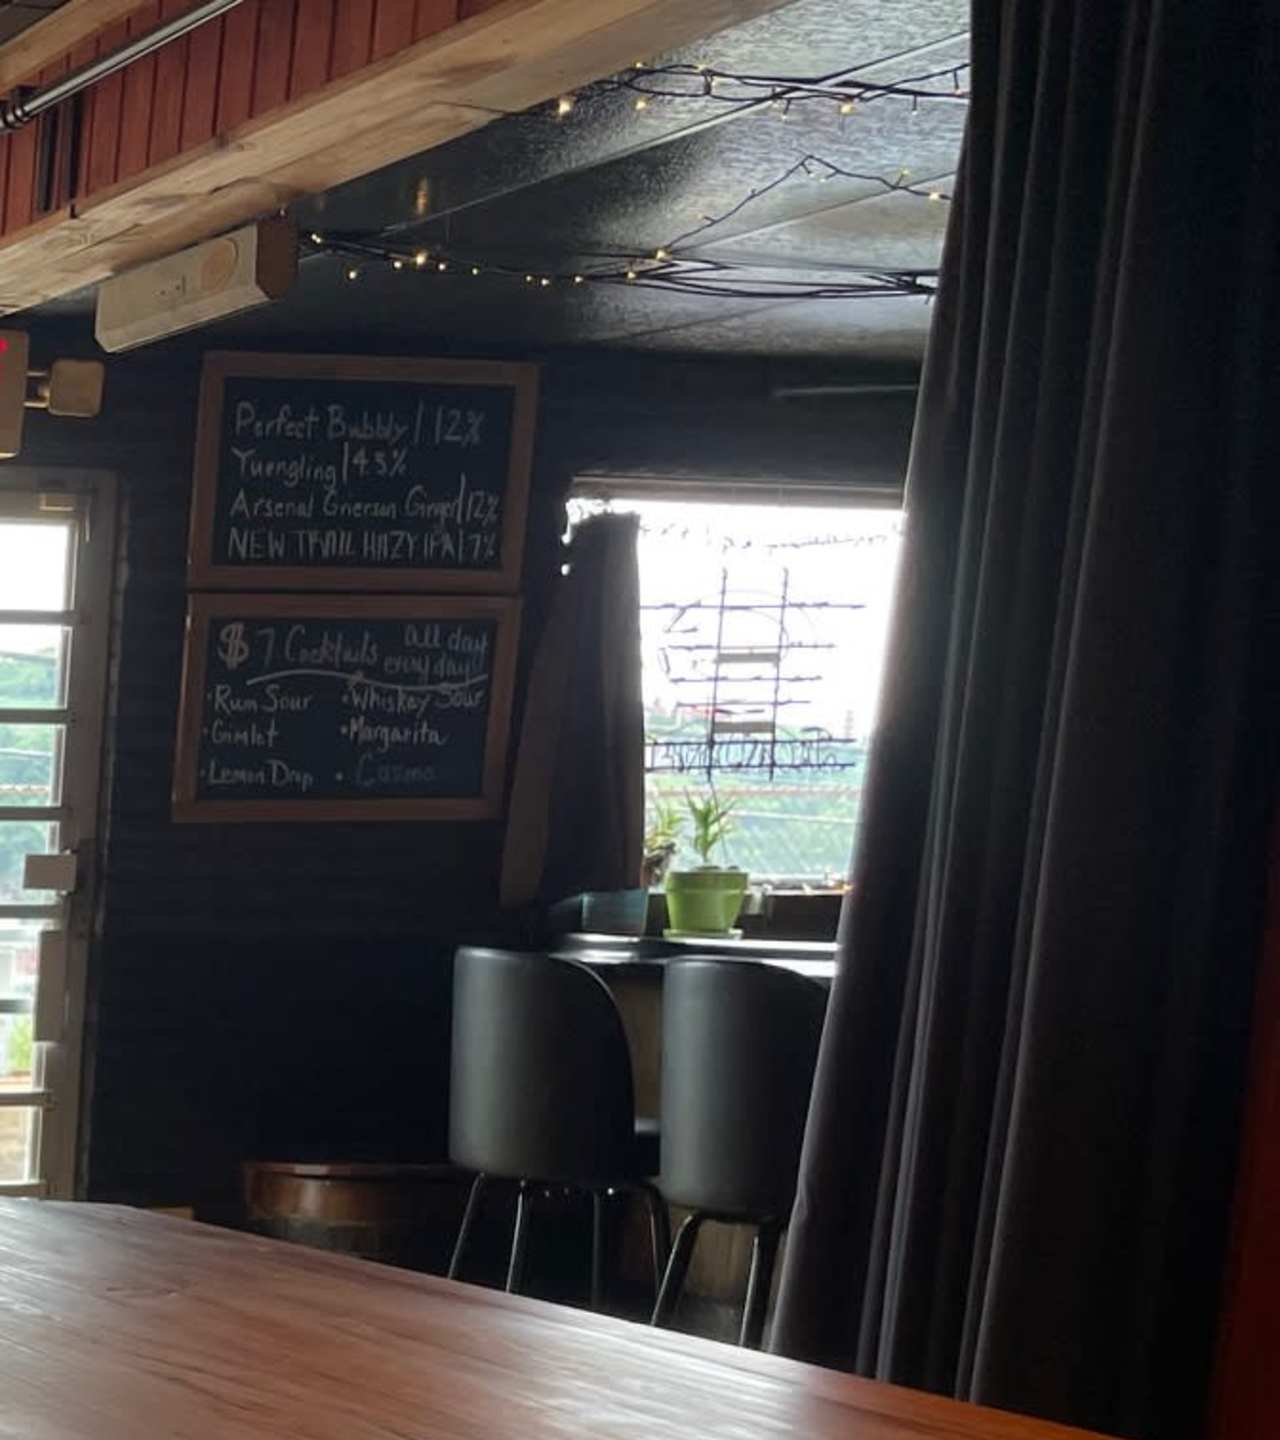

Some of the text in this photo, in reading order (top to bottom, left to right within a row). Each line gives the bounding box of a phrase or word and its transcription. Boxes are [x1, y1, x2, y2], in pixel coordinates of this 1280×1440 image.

[236, 401, 320, 440] Perfect
[327, 402, 409, 445] Bubbly
[230, 446, 337, 489] Yuengling
[229, 488, 314, 519] Arsenal
[228, 528, 285, 559] NEW
[362, 530, 419, 561] HAZY
[284, 624, 379, 669] Cocktails
[213, 684, 313, 716] Rum Sour
[434, 685, 485, 708] Sour
[211, 719, 279, 748] Gimlet
[349, 715, 450, 753] Margarita
[208, 758, 314, 792] Lemon Drop
